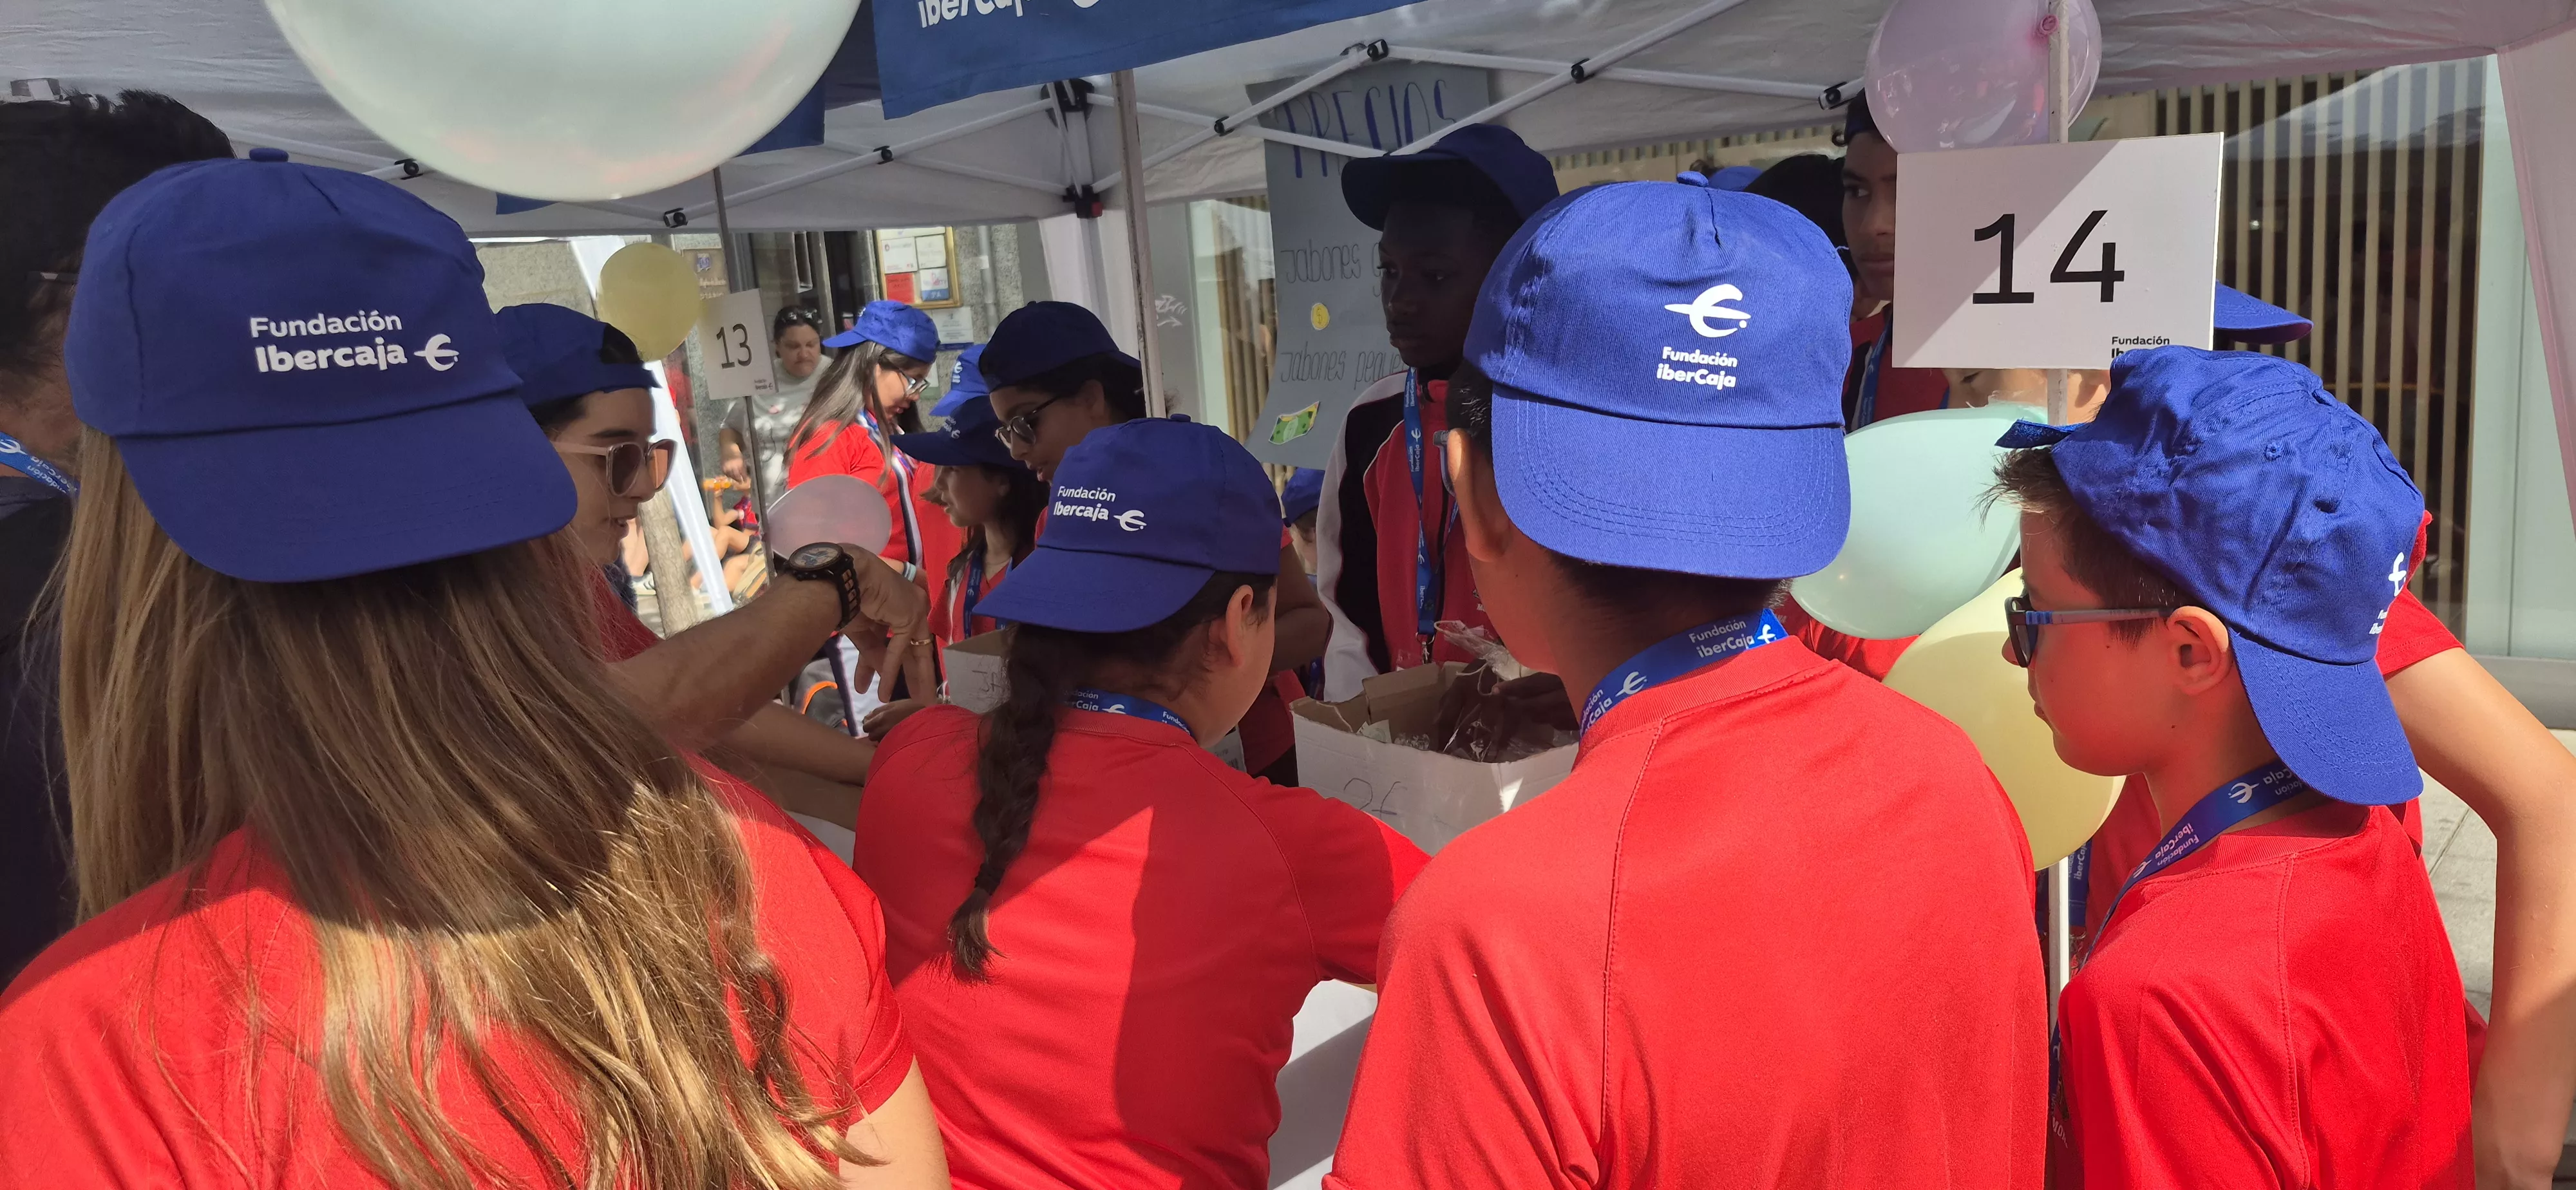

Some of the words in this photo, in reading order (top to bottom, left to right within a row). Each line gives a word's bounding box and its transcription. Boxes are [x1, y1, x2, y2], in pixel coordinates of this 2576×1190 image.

[918, 0, 1030, 28] iber
[1280, 239, 1361, 283] Jabones
[1972, 209, 2125, 305] 14
[250, 310, 402, 337] Fundación
[716, 323, 753, 370] 13
[2112, 336, 2170, 345] Fundación
[255, 337, 408, 372] Ibercaja
[1280, 341, 1347, 382] Jabones
[1662, 346, 1738, 368] Fundación
[1656, 363, 1737, 390] iberCaja
[1057, 486, 1116, 502] Fundación
[1054, 500, 1109, 521] Ibercaja
[1689, 619, 1747, 643] Fundación
[1696, 634, 1756, 659] iberCaja
[2263, 768, 2293, 786] Caja
[2155, 823, 2195, 860] iberCaja
[2157, 833, 2200, 867] Fundación
